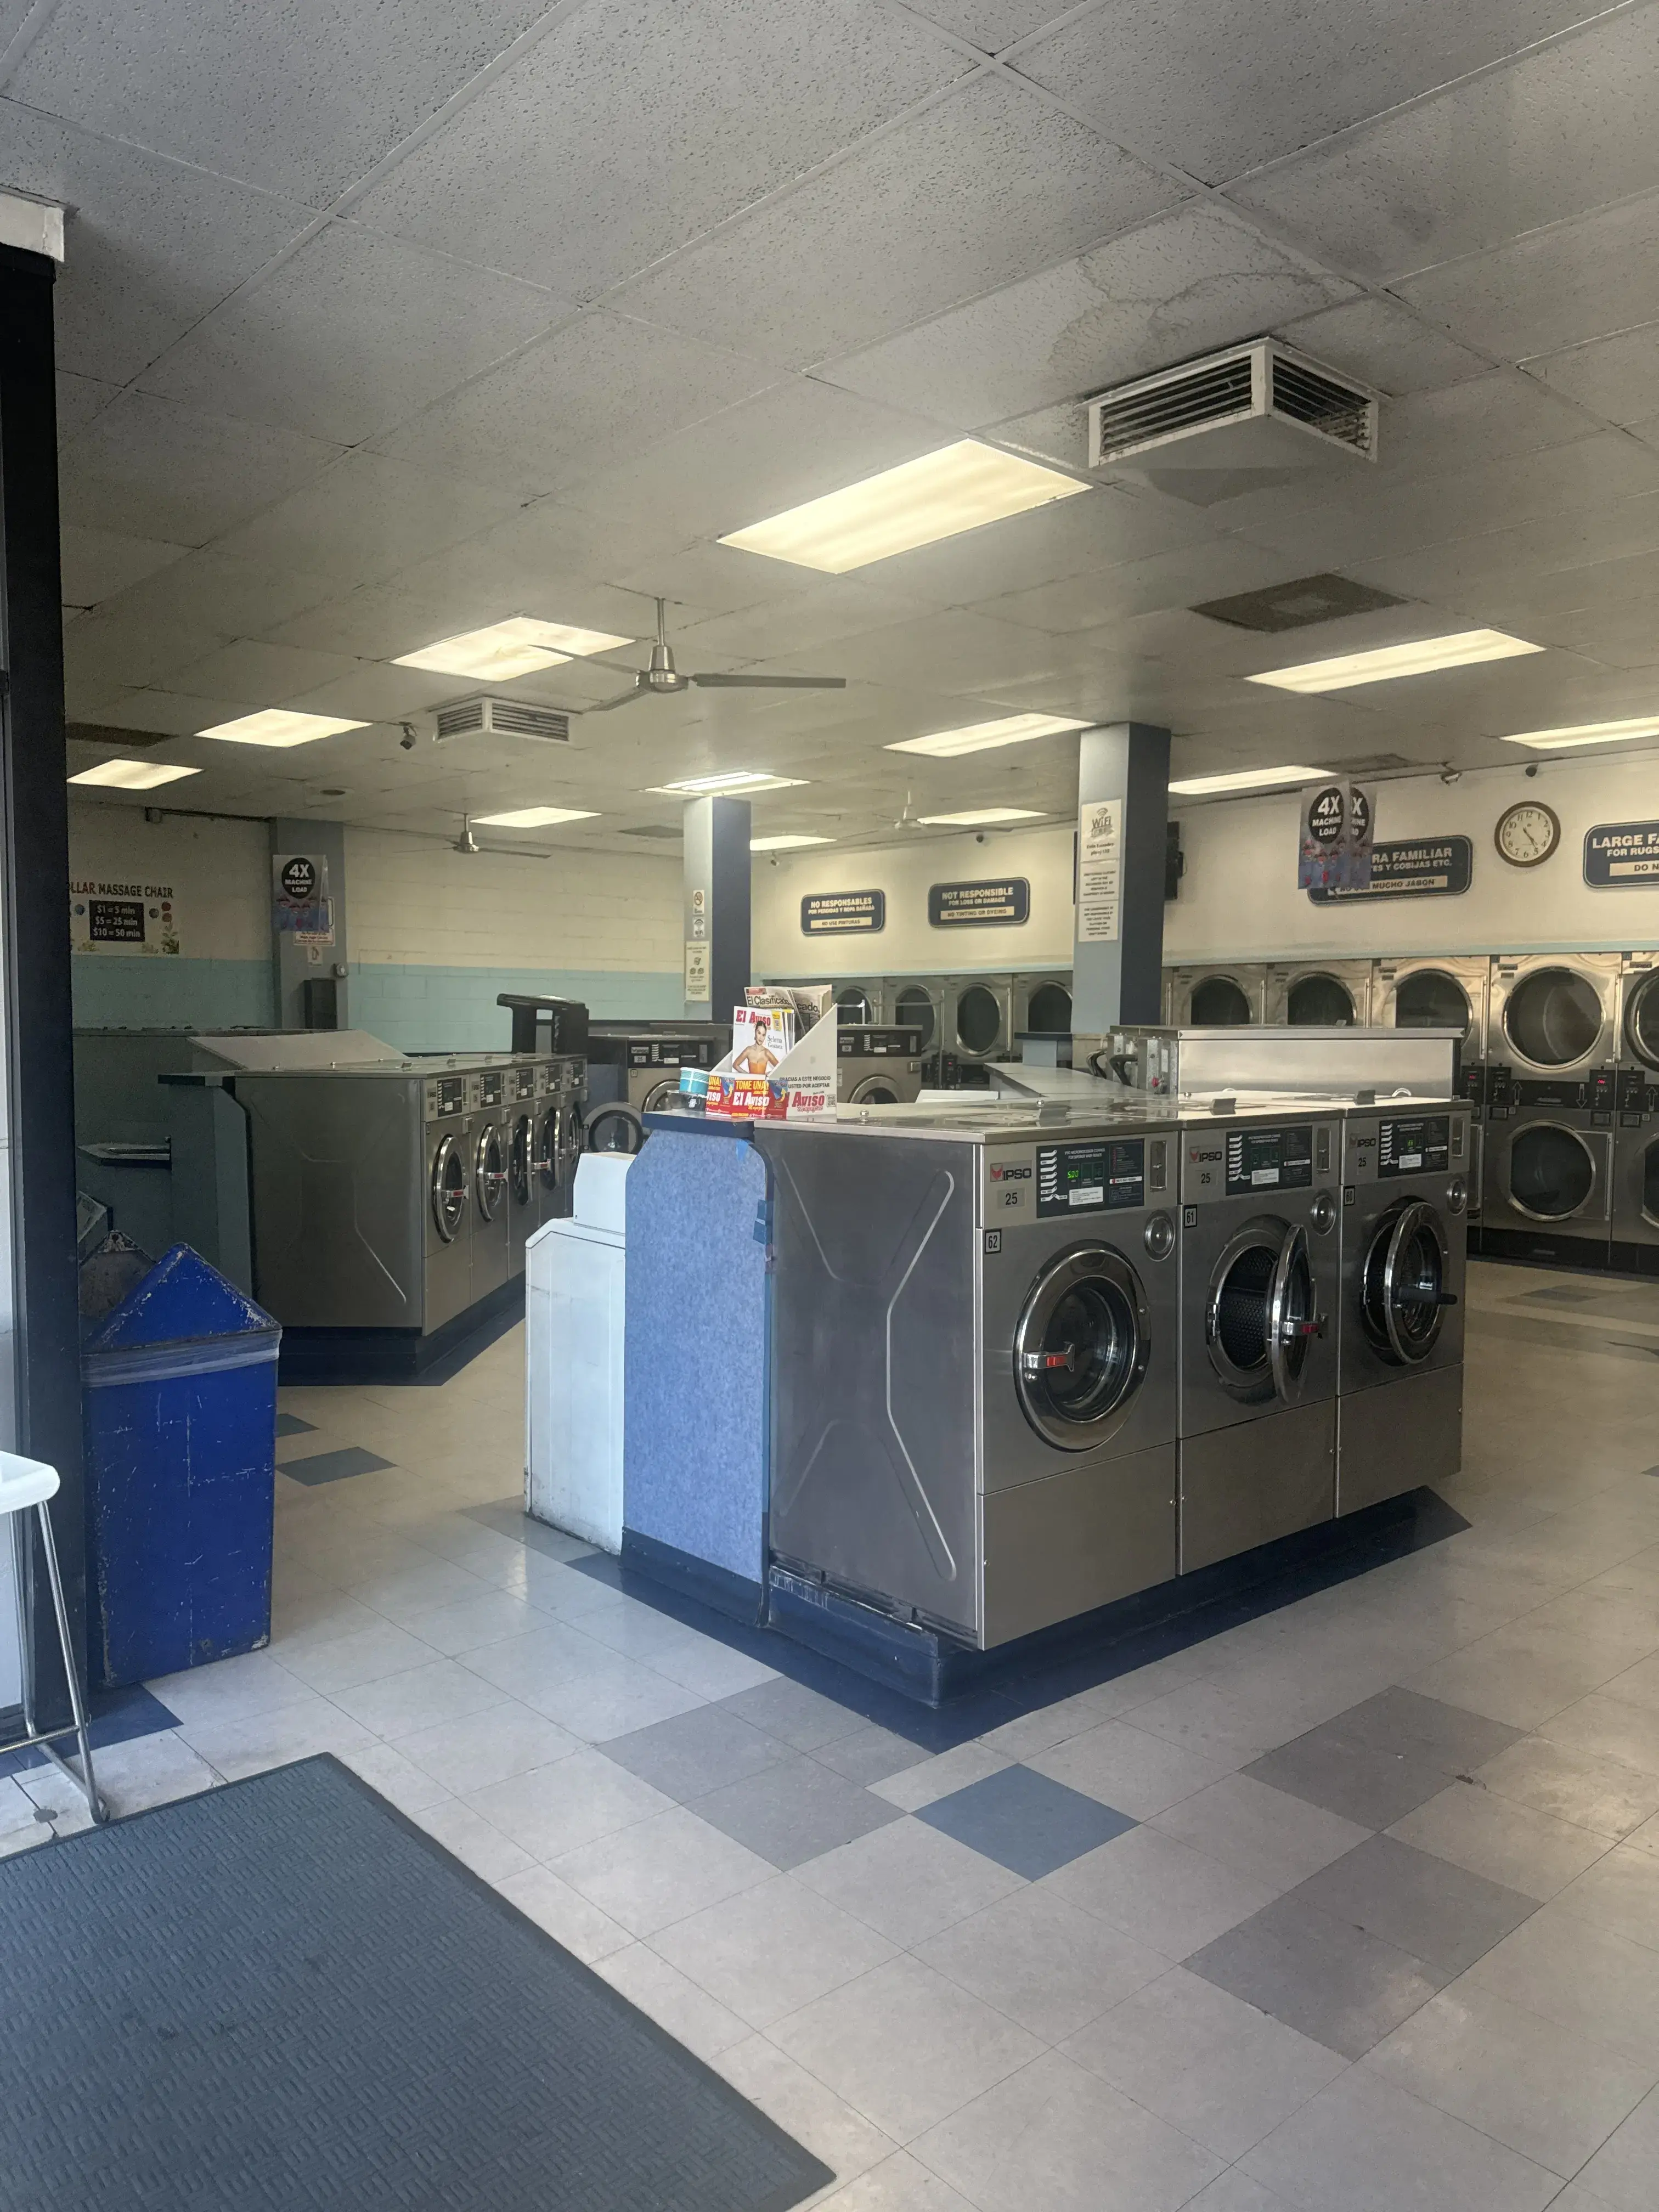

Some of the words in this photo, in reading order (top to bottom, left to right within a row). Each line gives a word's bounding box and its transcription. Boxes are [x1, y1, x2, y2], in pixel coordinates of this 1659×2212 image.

[1318, 796, 1340, 816] 4X
[1312, 815, 1341, 827] MACHINE
[1538, 812, 1541, 820] 1
[1319, 827, 1336, 836] LOAD
[1593, 834, 1643, 849] LARGE
[1392, 848, 1452, 862] FAMILIAR
[1533, 847, 1539, 855] 5
[1607, 848, 1628, 857] FOR
[289, 864, 309, 878] 4X
[1393, 861, 1430, 870] COBIJAS
[98, 883, 142, 896] MASSAGE
[145, 886, 173, 898] CHAIR
[942, 891, 958, 900] NOT
[960, 887, 1013, 898] RESPONSIBLE
[822, 897, 872, 907] RESPONSABLES
[97, 905, 106, 913] $1
[95, 917, 104, 925] $5
[93, 928, 107, 936] $10
[116, 928, 125, 936] 50
[747, 996, 753, 1005] El
[736, 1009, 747, 1023] El
[736, 1080, 752, 1090] TOME
[753, 1080, 769, 1091] UNA!
[732, 1092, 744, 1106] El
[1357, 1138, 1376, 1148] IPSO
[1199, 1152, 1222, 1163] IPSO
[1358, 1158, 1367, 1167] 25
[1003, 1168, 1031, 1181] IPSO
[1201, 1173, 1210, 1184] 25
[1006, 1192, 1018, 1205] 25
[1187, 1211, 1194, 1223] 61
[988, 1235, 998, 1249] 62
